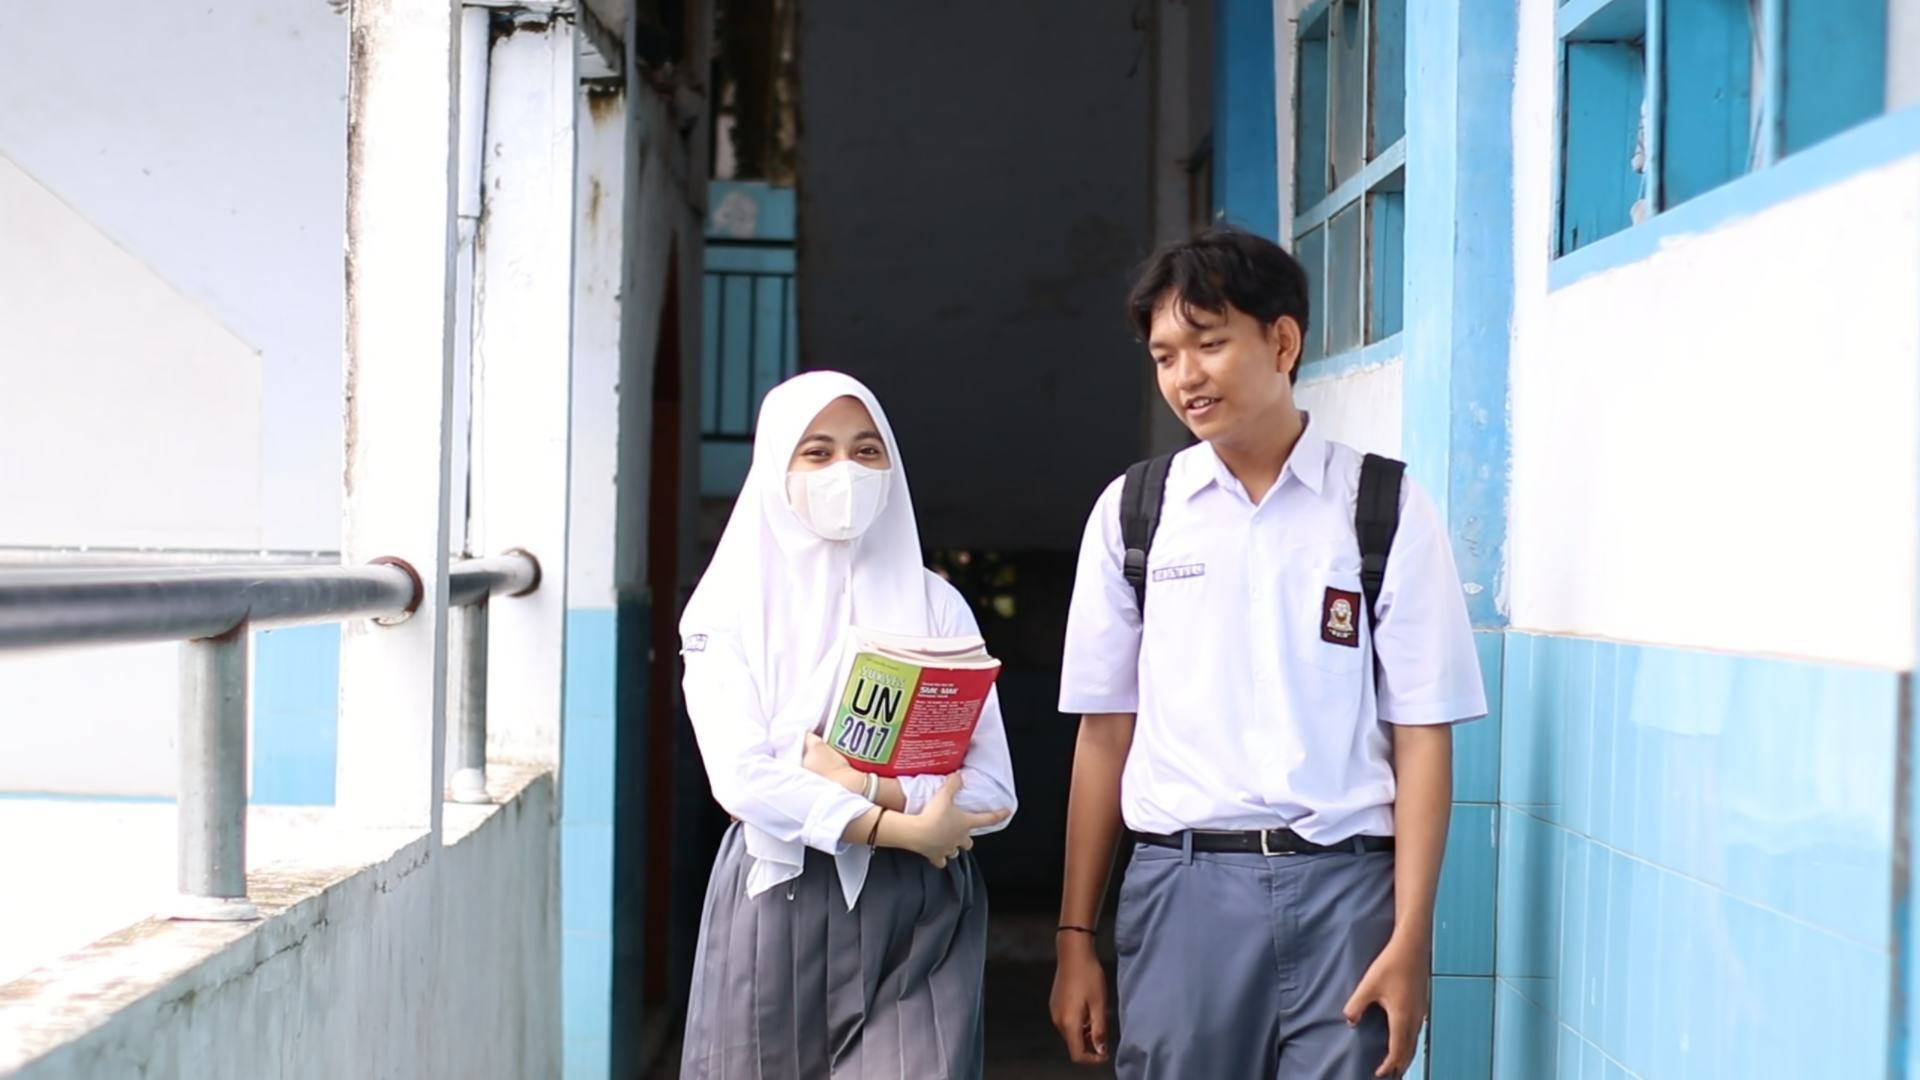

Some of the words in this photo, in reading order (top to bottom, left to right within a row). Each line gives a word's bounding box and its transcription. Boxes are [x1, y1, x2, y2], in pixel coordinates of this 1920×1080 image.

[861, 666, 906, 689] SUKSES
[851, 679, 903, 723] UN
[837, 716, 890, 760] 2017
